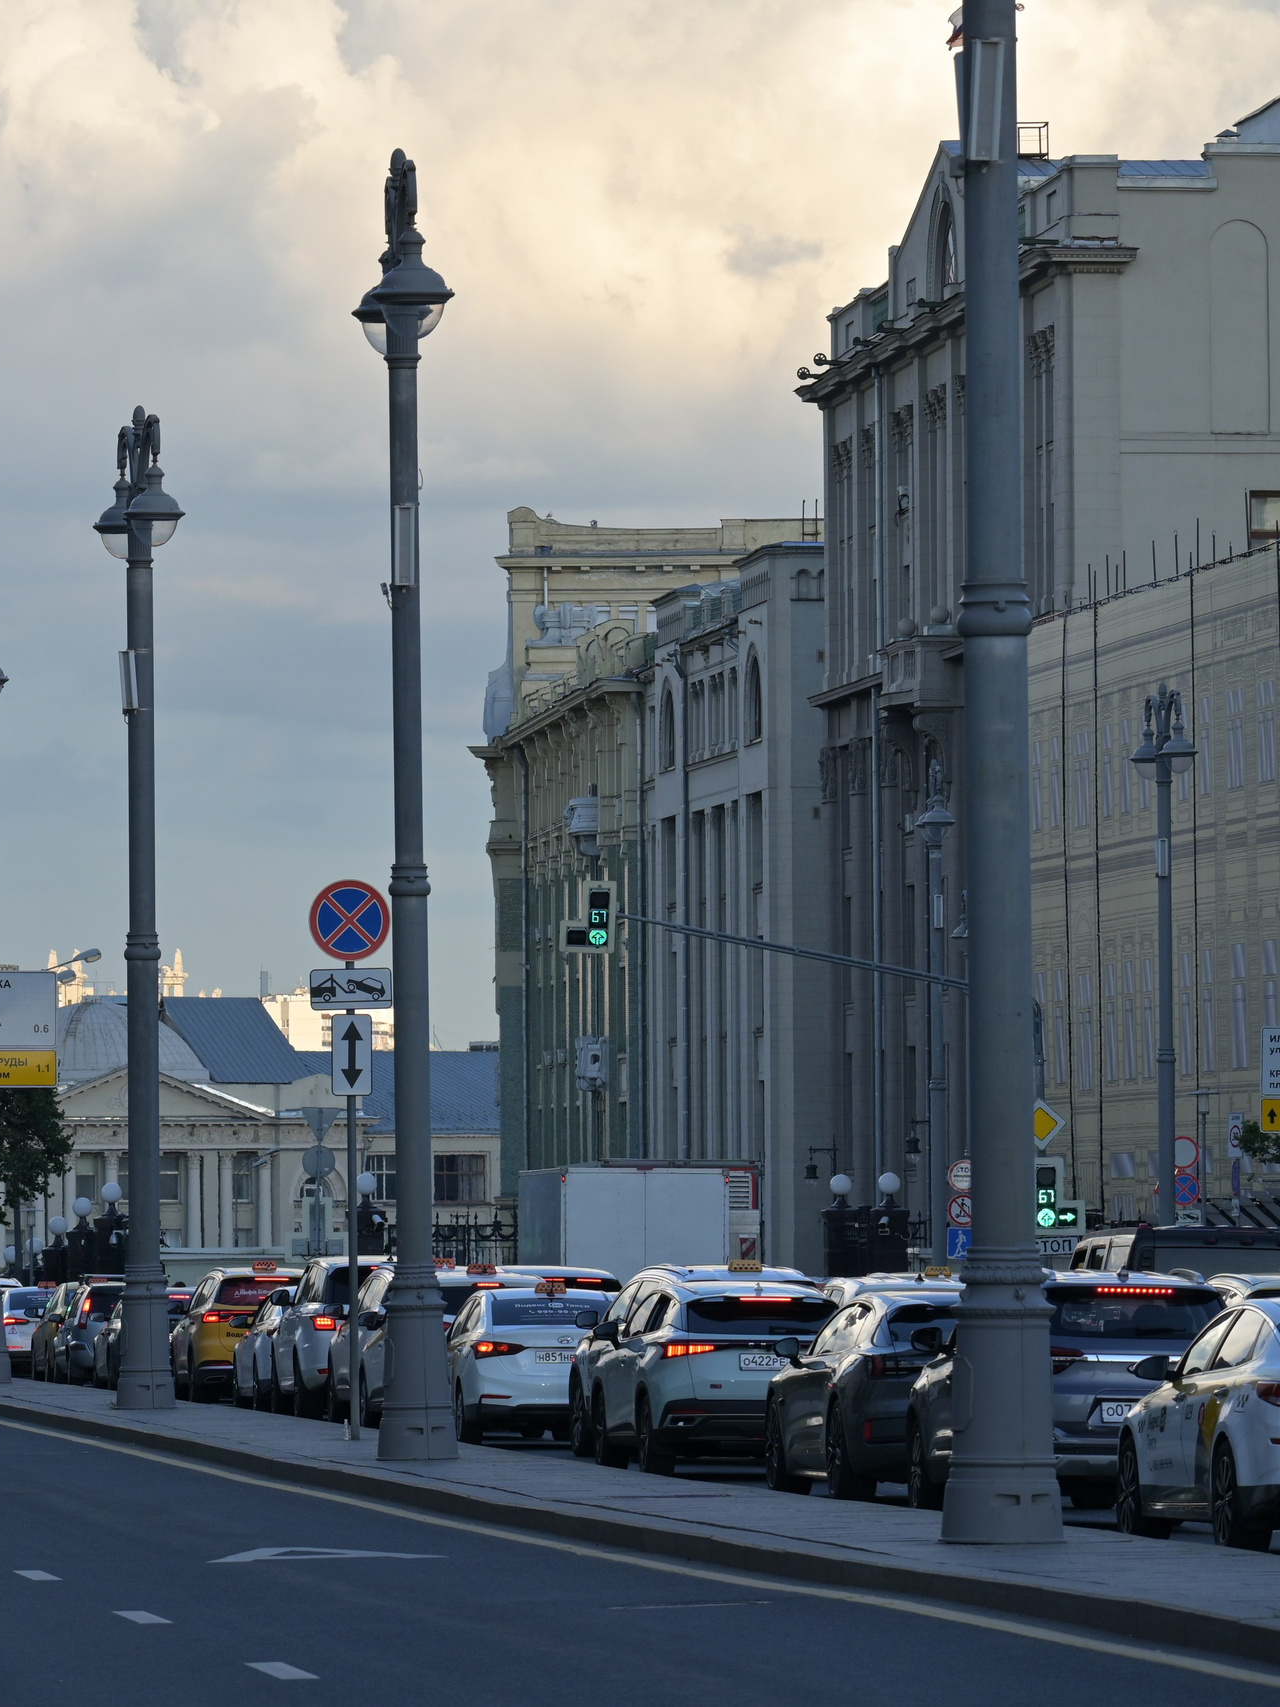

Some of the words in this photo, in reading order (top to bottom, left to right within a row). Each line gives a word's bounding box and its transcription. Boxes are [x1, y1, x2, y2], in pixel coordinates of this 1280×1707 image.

[591, 910, 607, 923] 67
[33, 1024, 49, 1033] 0.6
[36, 1064, 50, 1073] 1.1
[1038, 1189, 1055, 1204] 67
[1036, 1239, 1072, 1253] ТОП
